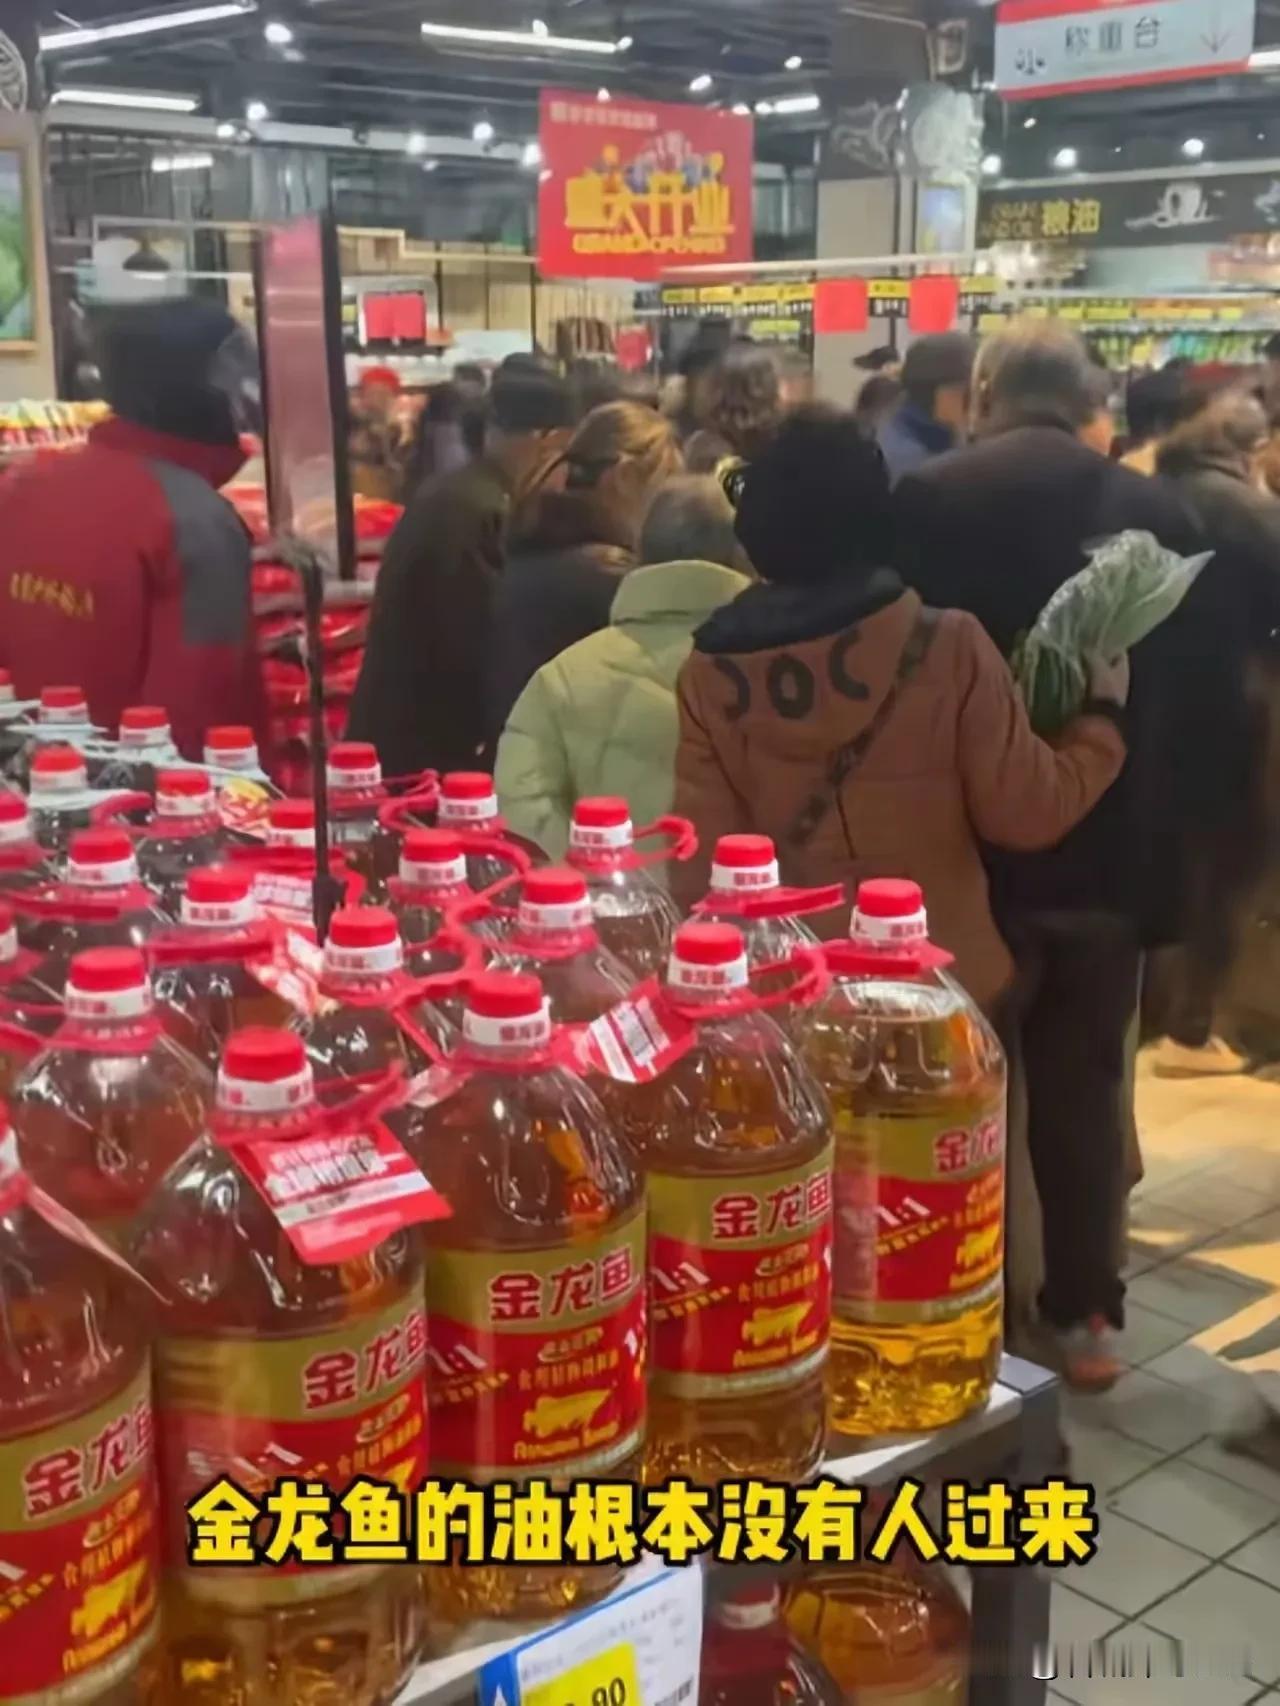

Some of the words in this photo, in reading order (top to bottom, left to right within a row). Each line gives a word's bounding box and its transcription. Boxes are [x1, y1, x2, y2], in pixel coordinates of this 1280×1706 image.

[712, 1168, 832, 1240] 金龙鱼
[489, 1244, 633, 1322] 金龙鱼
[304, 1308, 427, 1411] 金龙鱼
